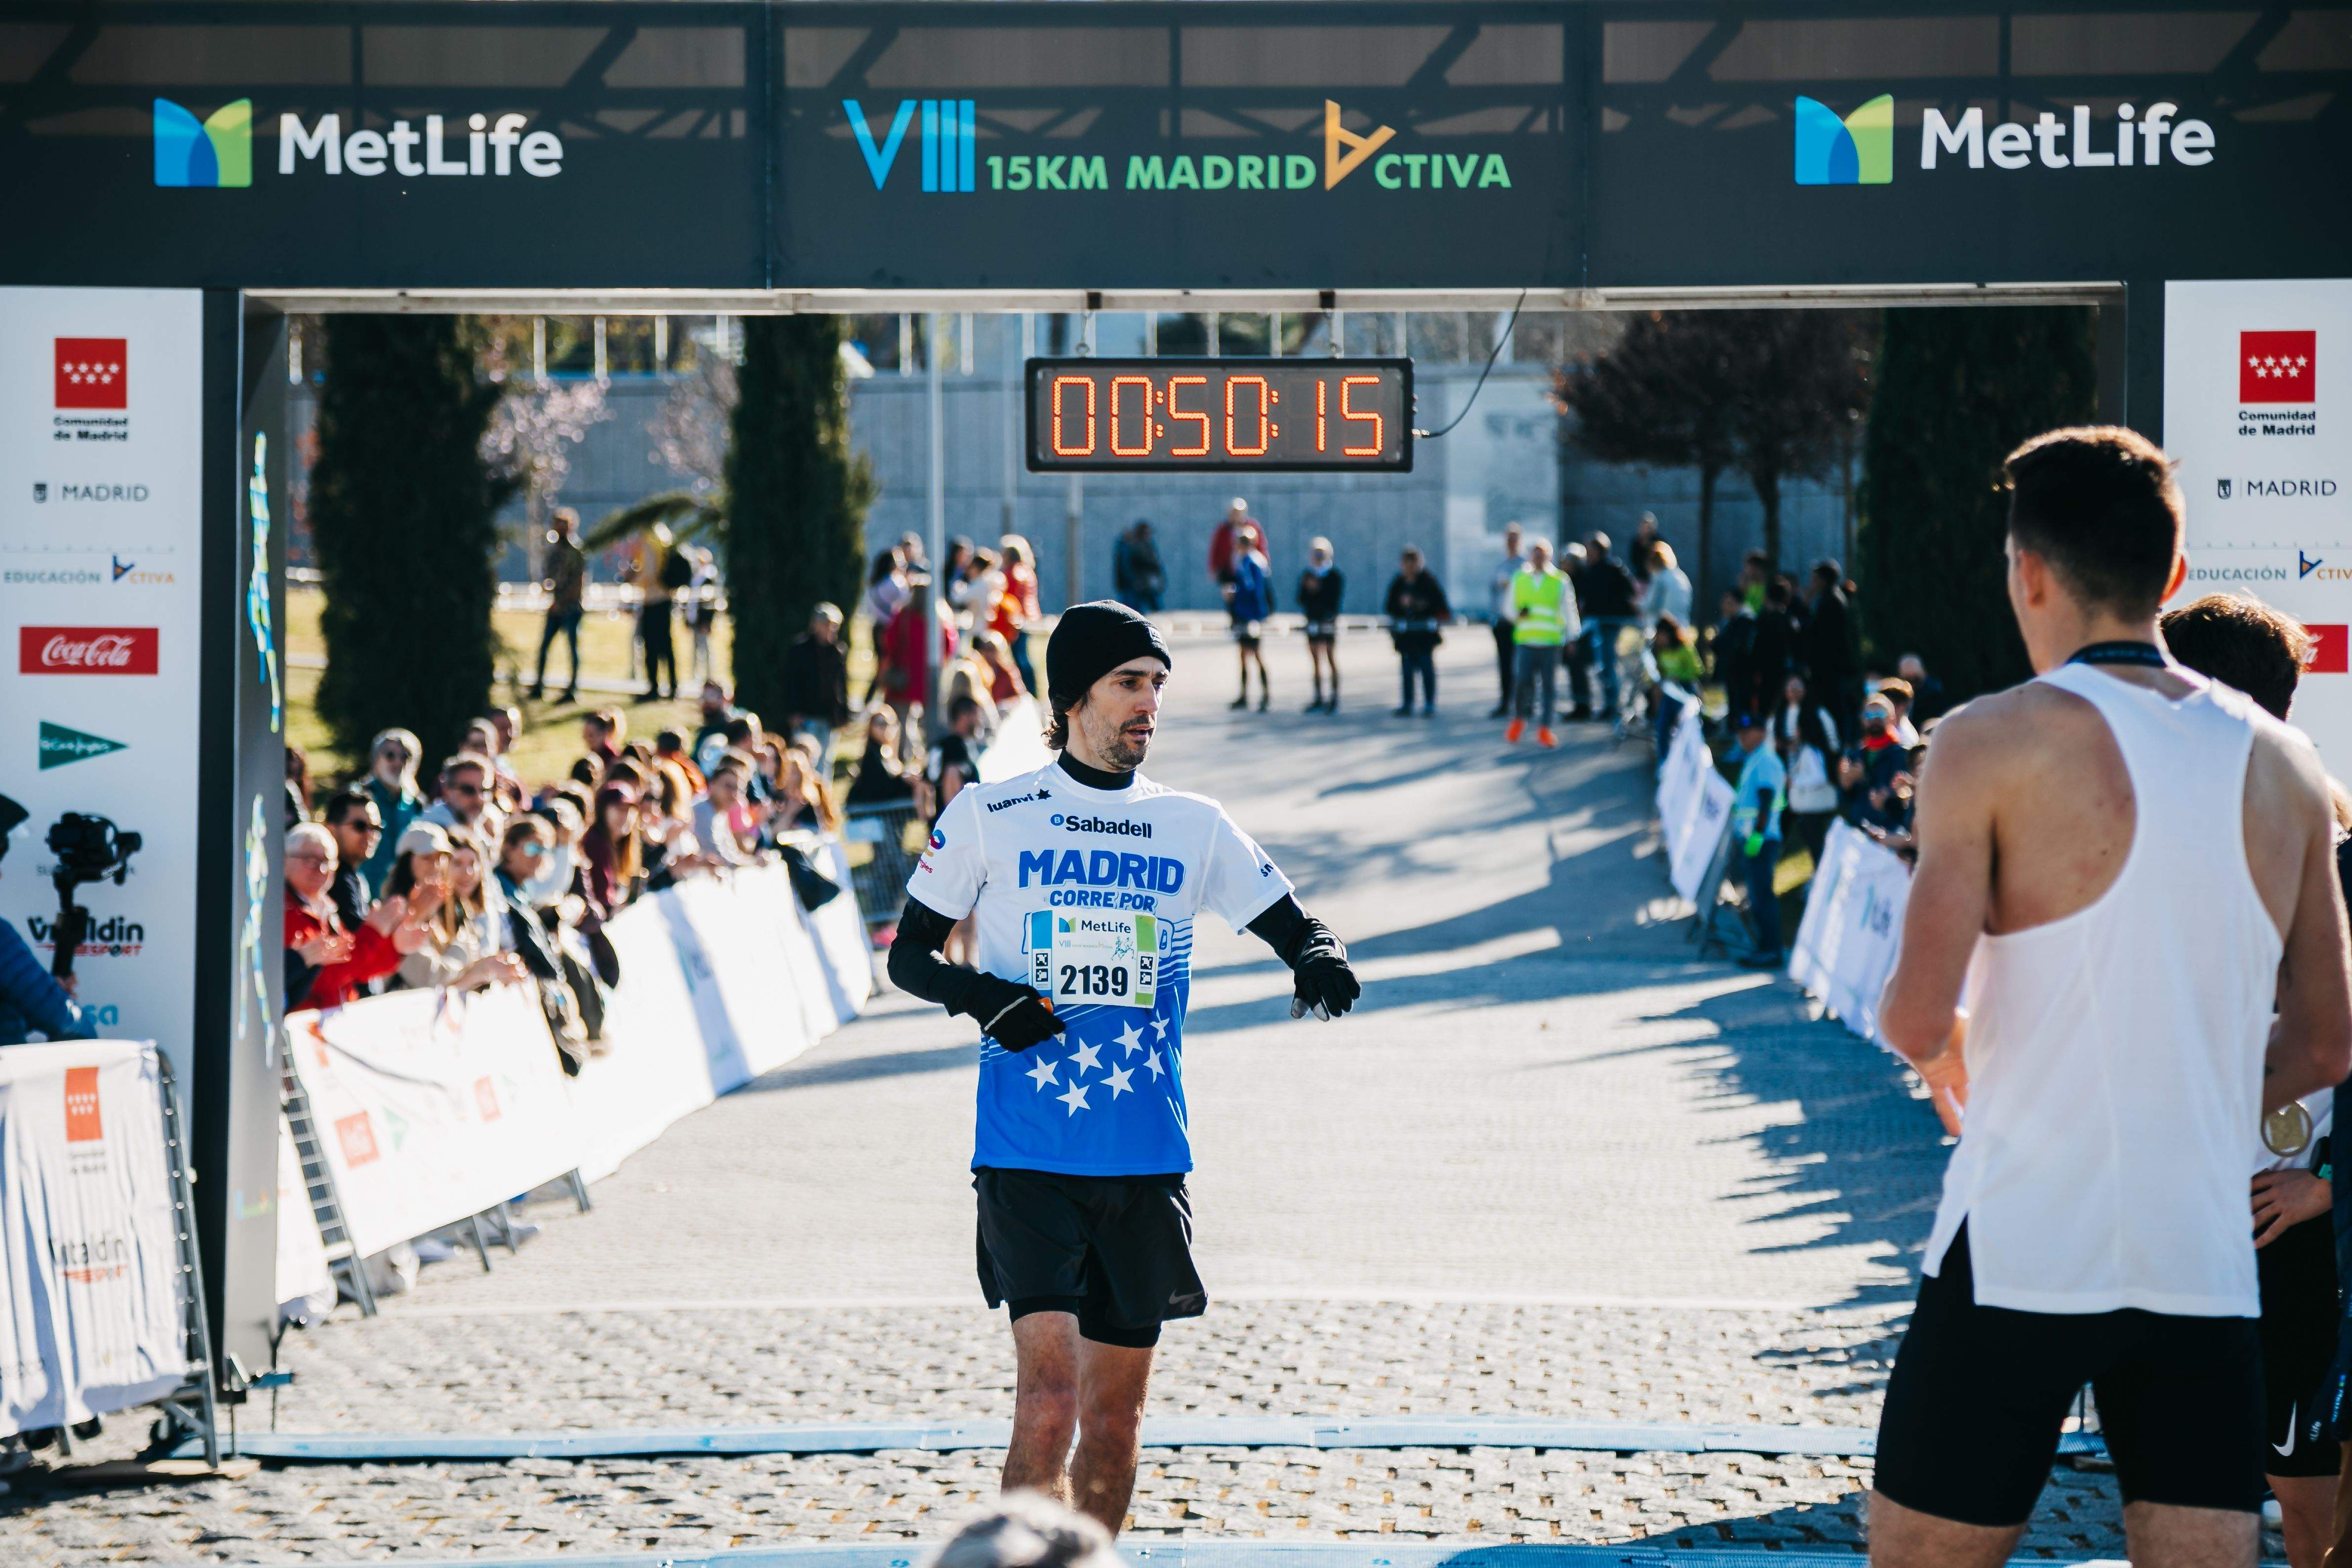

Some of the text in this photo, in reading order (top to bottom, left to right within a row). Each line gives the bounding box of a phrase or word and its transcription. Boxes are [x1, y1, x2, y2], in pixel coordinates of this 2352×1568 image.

[279, 113, 563, 177] MetLife
[1920, 102, 2215, 169] MetLife
[842, 100, 975, 192] VIII
[986, 155, 1108, 190] 15KM
[1126, 155, 1316, 190] MADRID
[53, 417, 128, 426] Comunidad
[2238, 410, 2316, 421] Comunidad
[53, 431, 128, 441] de Madrid
[2238, 423, 2316, 436] de Madrid
[62, 484, 149, 502] MADRID
[2248, 480, 2337, 497] MADRID
[2188, 549, 2352, 581] EDUCACIÓN ACTIV
[3, 568, 101, 584] EDUCACIÓN
[41, 634, 136, 666] Coca-Cola
[987, 793, 1035, 812] luanvi
[1065, 815, 1152, 839] Sabadell
[1018, 849, 1185, 894] MADRID
[1049, 890, 1156, 912] CORRE POR
[1081, 920, 1131, 933] MetLife
[1060, 965, 1128, 997] 2139
